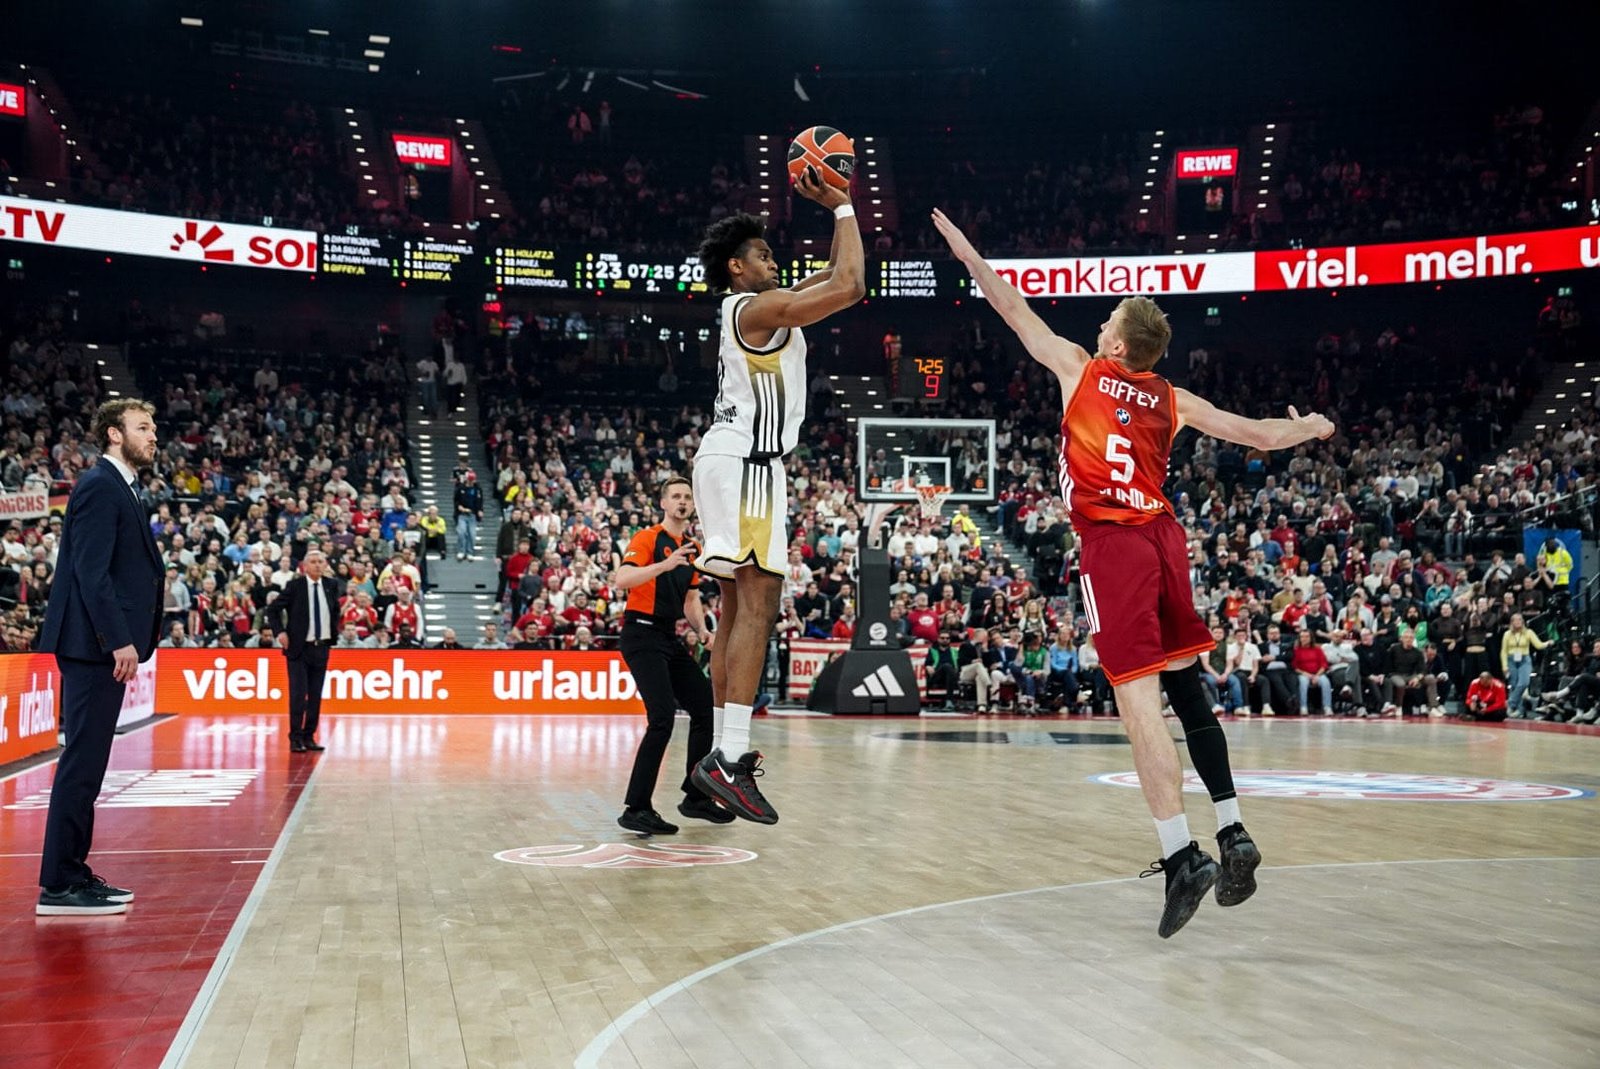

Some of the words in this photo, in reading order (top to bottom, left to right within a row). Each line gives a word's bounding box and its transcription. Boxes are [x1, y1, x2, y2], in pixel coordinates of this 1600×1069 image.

[396, 140, 445, 160] REWE
[1183, 154, 1233, 173] REWE
[596, 261, 622, 279] 23
[628, 263, 674, 280] 07:25
[679, 264, 705, 282] 20
[1278, 246, 1369, 289] viel.
[1404, 236, 1533, 284] mehr.
[925, 375, 940, 398] 9
[1098, 376, 1160, 409] GIFFEY
[1105, 433, 1136, 484] 5
[182, 657, 282, 700] viel.
[321, 658, 449, 700] mehr.
